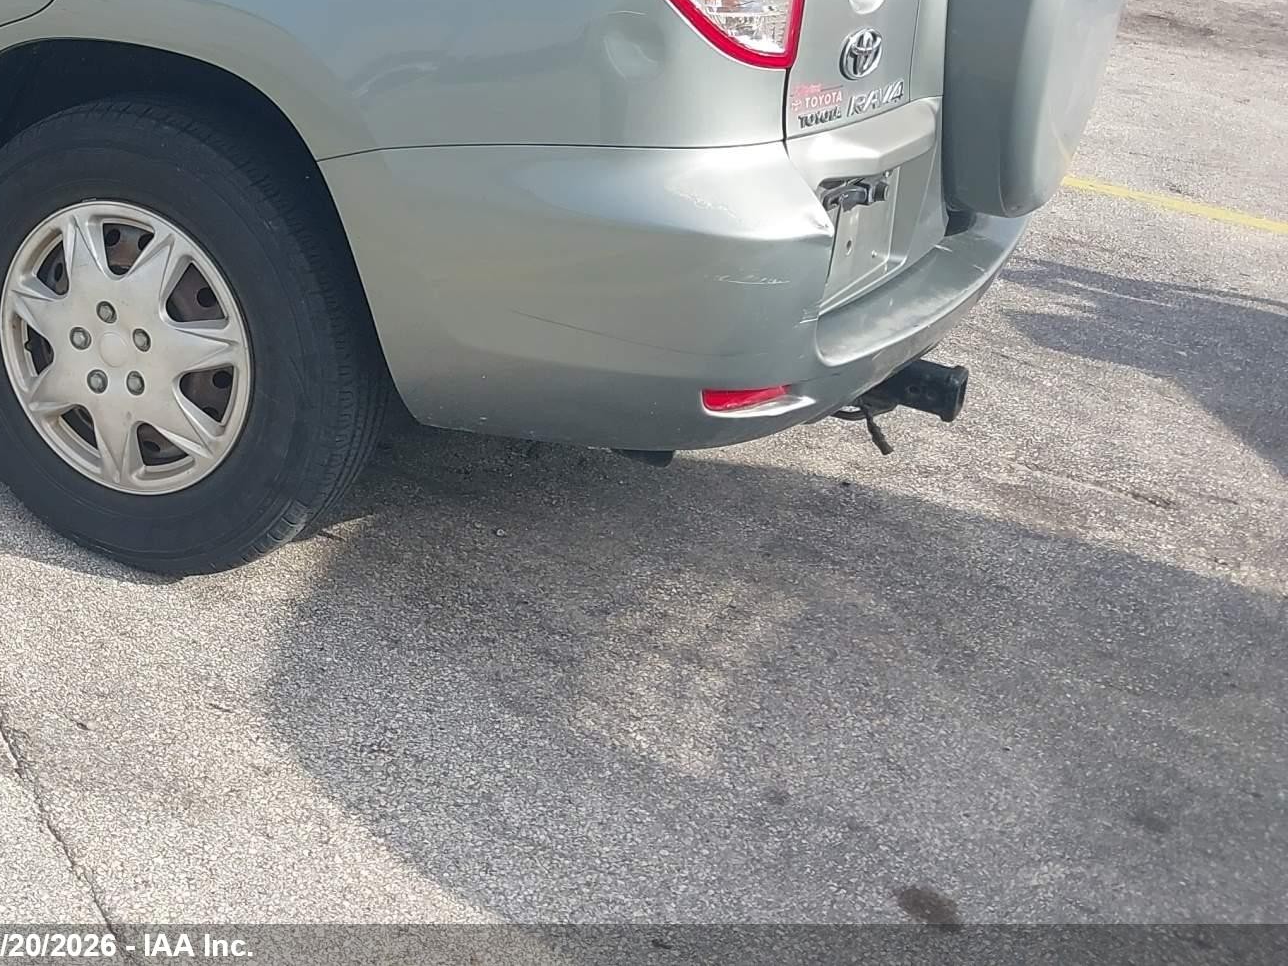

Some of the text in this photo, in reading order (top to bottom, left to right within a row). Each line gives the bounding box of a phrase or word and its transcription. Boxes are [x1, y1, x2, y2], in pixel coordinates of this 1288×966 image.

[798, 105, 842, 129] TOYOTA
[847, 78, 905, 117] RAV4
[805, 90, 843, 108] TOYOTA
